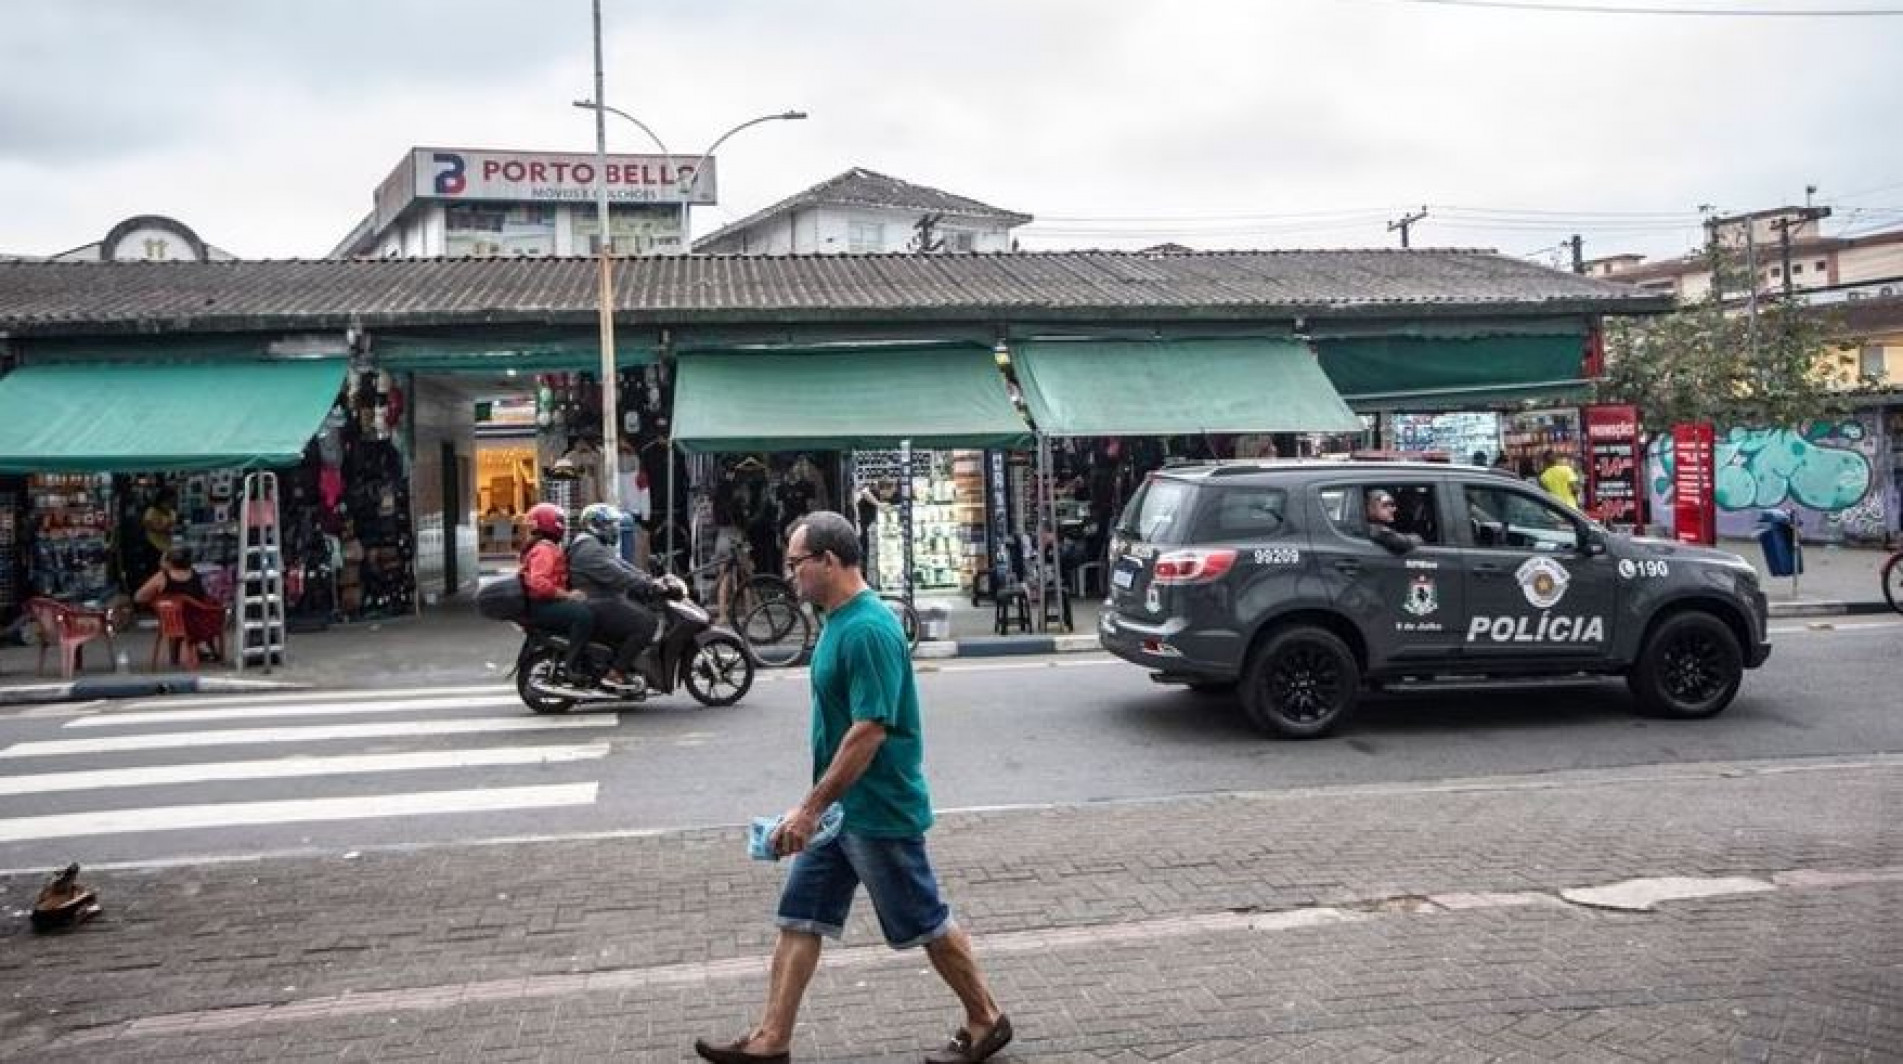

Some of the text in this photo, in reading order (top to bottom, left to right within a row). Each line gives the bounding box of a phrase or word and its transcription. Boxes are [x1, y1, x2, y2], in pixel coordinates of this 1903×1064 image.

[1254, 549, 1299, 564] 99209
[1637, 560, 1669, 577] 190
[1466, 610, 1604, 642] POLÍCIA
